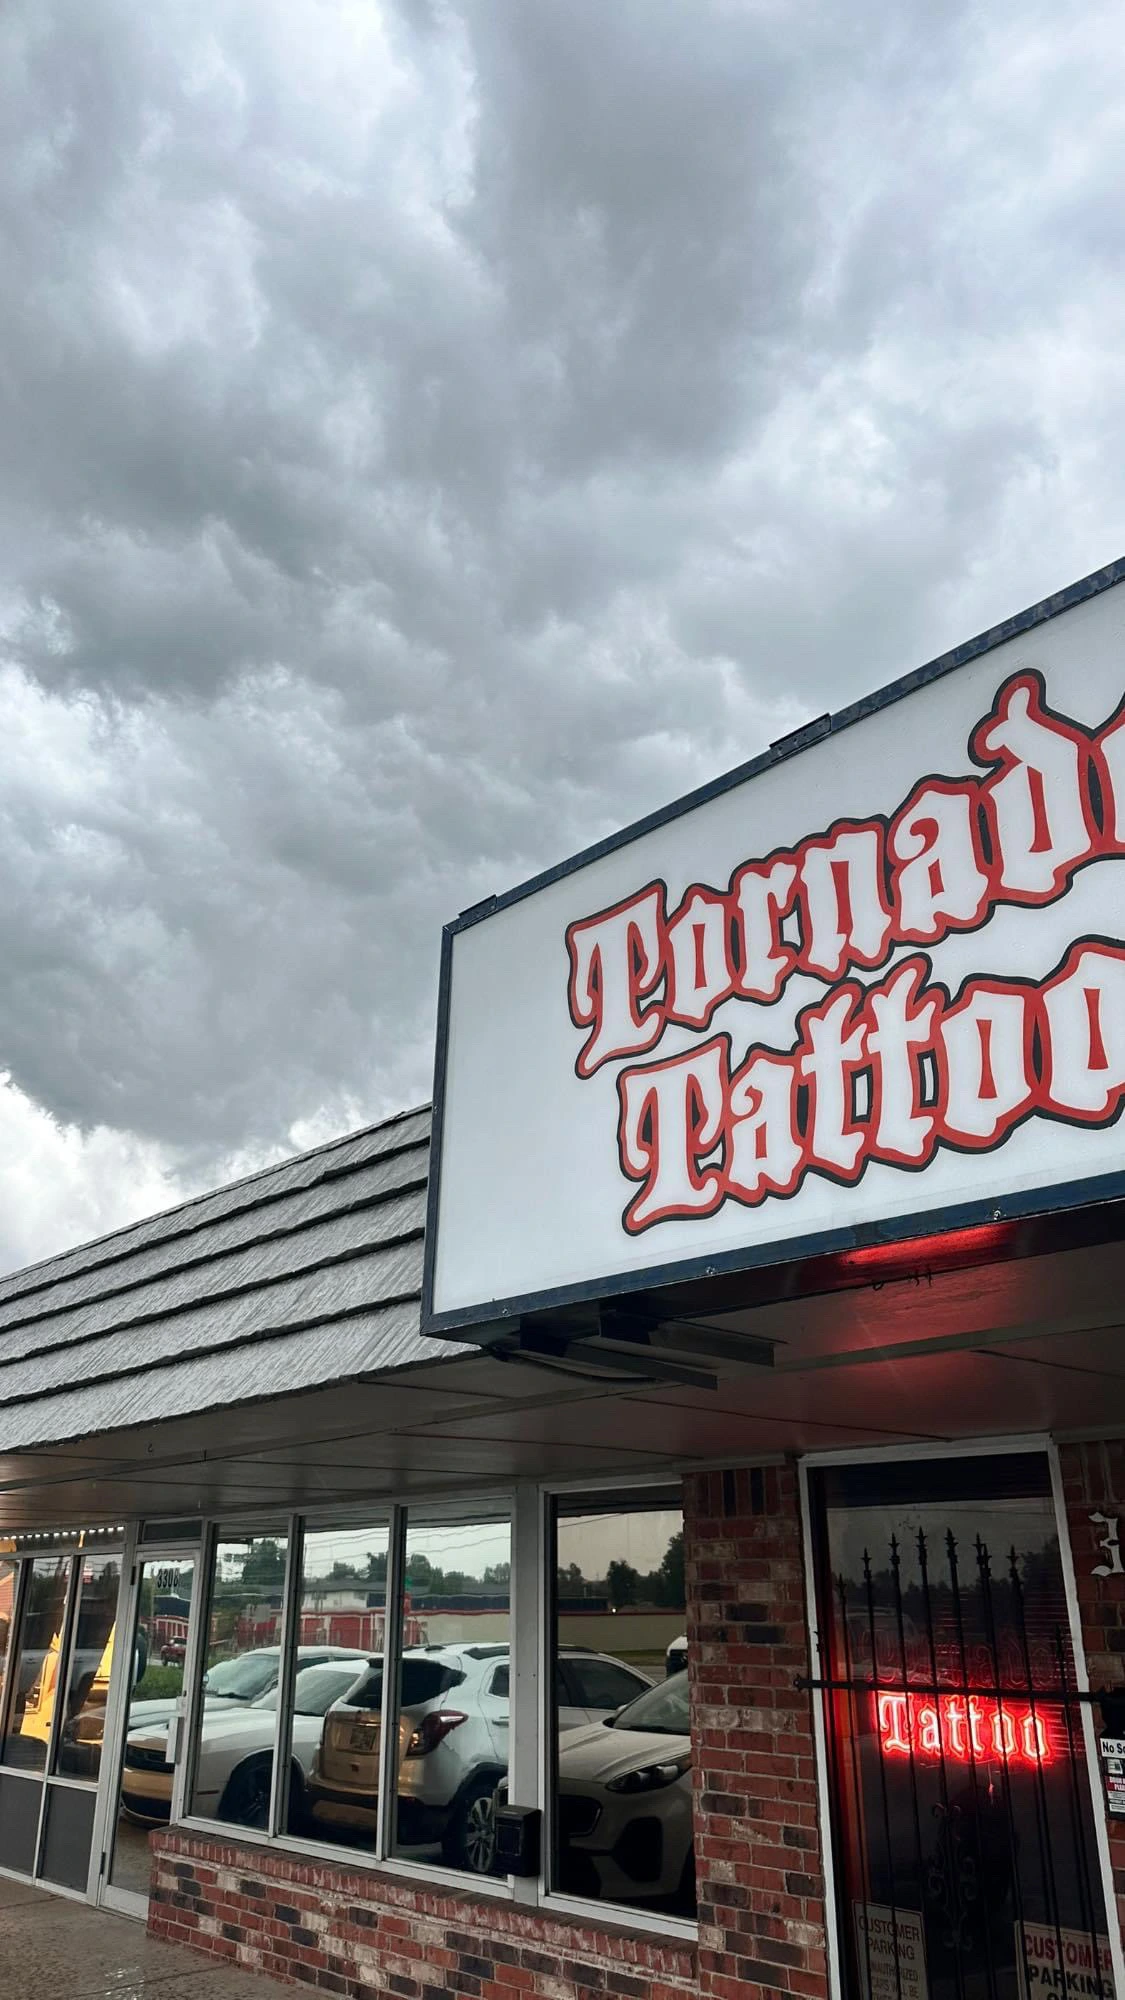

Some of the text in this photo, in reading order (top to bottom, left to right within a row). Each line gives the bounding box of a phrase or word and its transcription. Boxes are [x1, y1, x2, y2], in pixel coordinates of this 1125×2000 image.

[565, 667, 1125, 1080] Tornad
[617, 935, 1125, 1236] Tattoo
[876, 1691, 1052, 1760] Tattoo
[1102, 1741, 1115, 1754] No
[867, 1936, 915, 1961] PARKNG
[1024, 1934, 1113, 1971] CUSOMER
